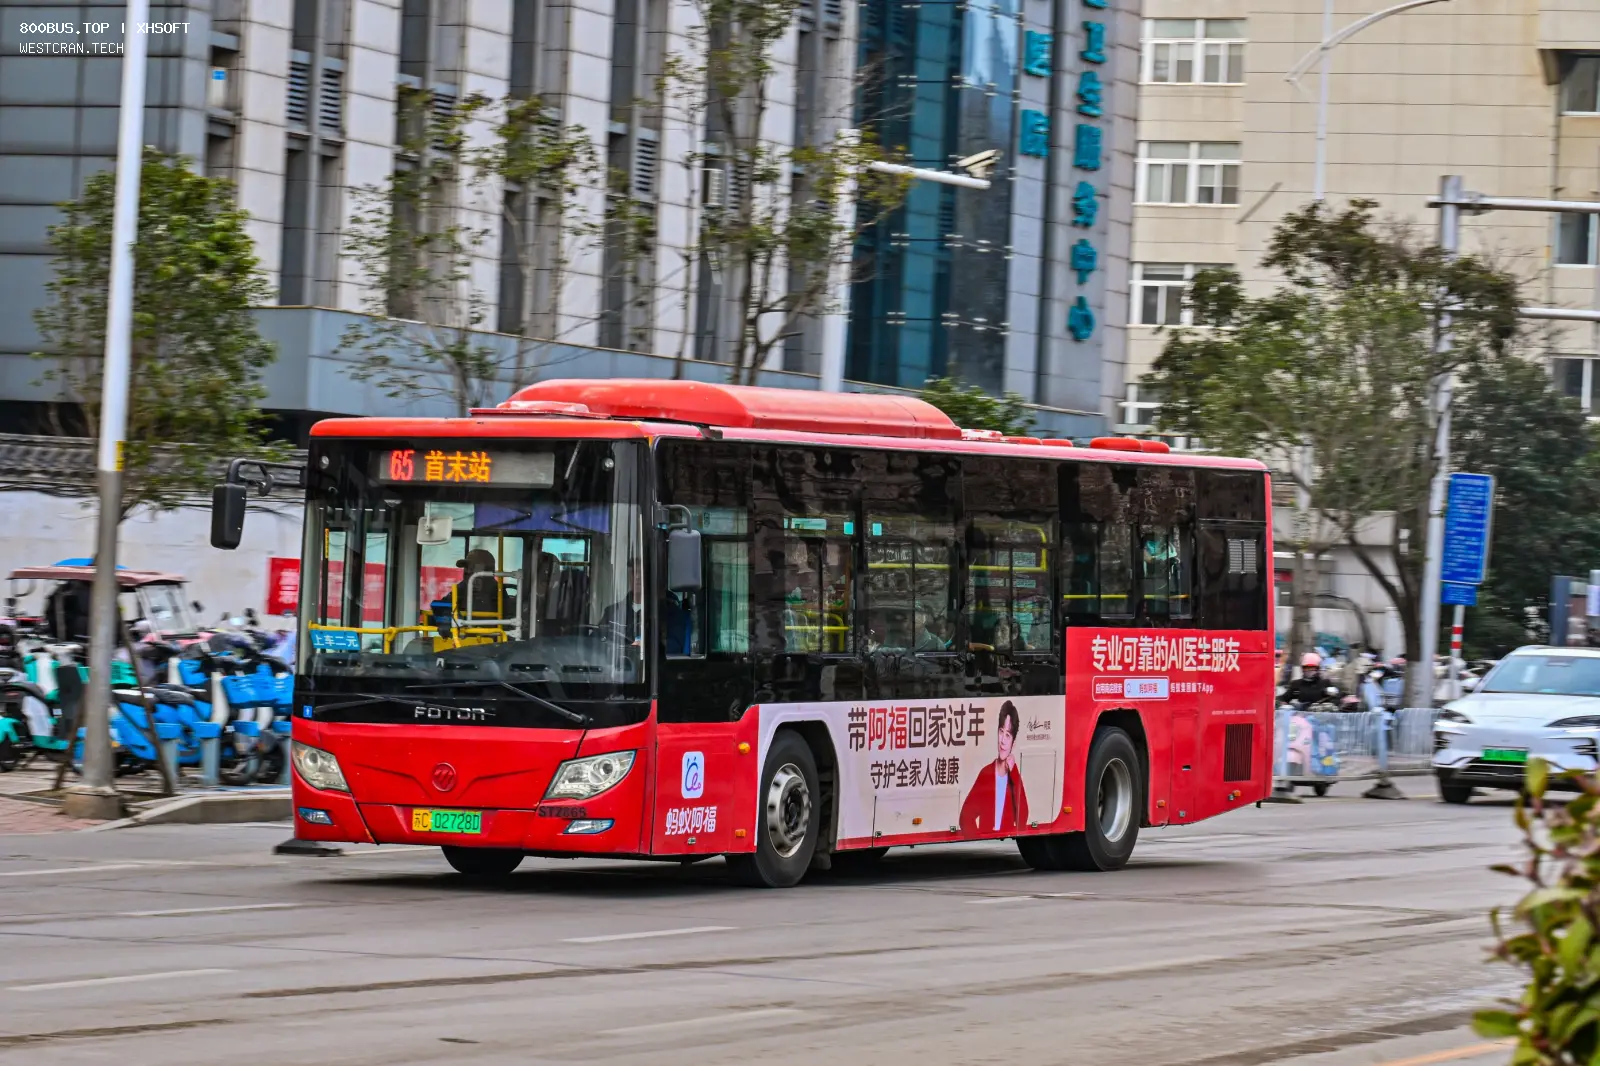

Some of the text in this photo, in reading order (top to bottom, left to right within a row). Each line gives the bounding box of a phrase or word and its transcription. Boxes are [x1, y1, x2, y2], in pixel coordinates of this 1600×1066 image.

[1067, 0, 1108, 341] 卫生服务中心
[390, 450, 492, 482] 65 首末站
[313, 634, 359, 648] 上车二元
[1091, 634, 1240, 673] 专业可靠的AI医生朋友
[414, 706, 485, 721] FOTON
[848, 702, 986, 752] 带阿福回家过年
[870, 756, 960, 790] 守护全家人健康
[664, 805, 718, 836] 蚂蚁阿福
